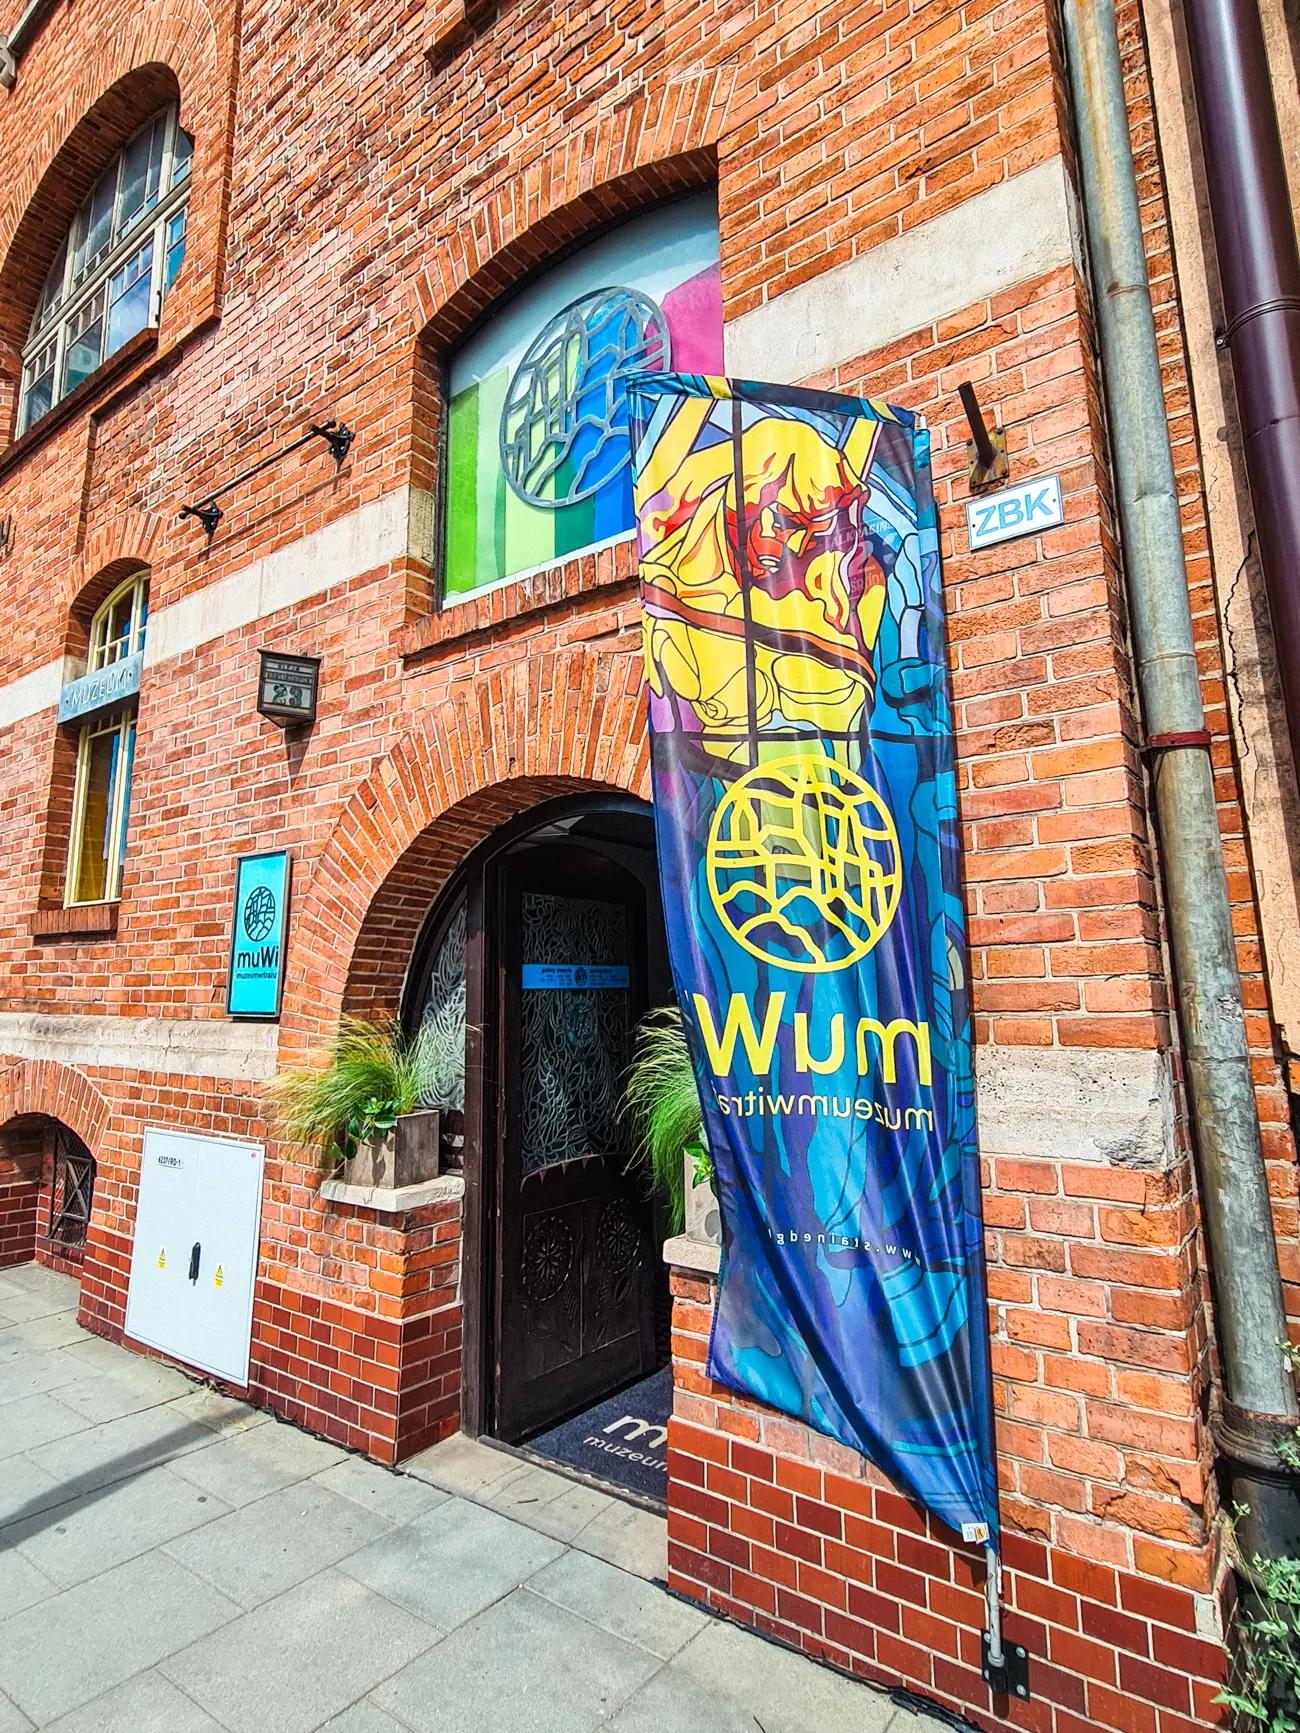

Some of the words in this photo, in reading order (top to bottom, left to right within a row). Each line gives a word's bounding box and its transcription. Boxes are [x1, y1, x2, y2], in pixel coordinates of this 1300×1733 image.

[975, 487, 1054, 537] ZBK
[71, 667, 128, 709] MUZEUM
[272, 683, 303, 708] 23
[237, 945, 279, 968] muWi
